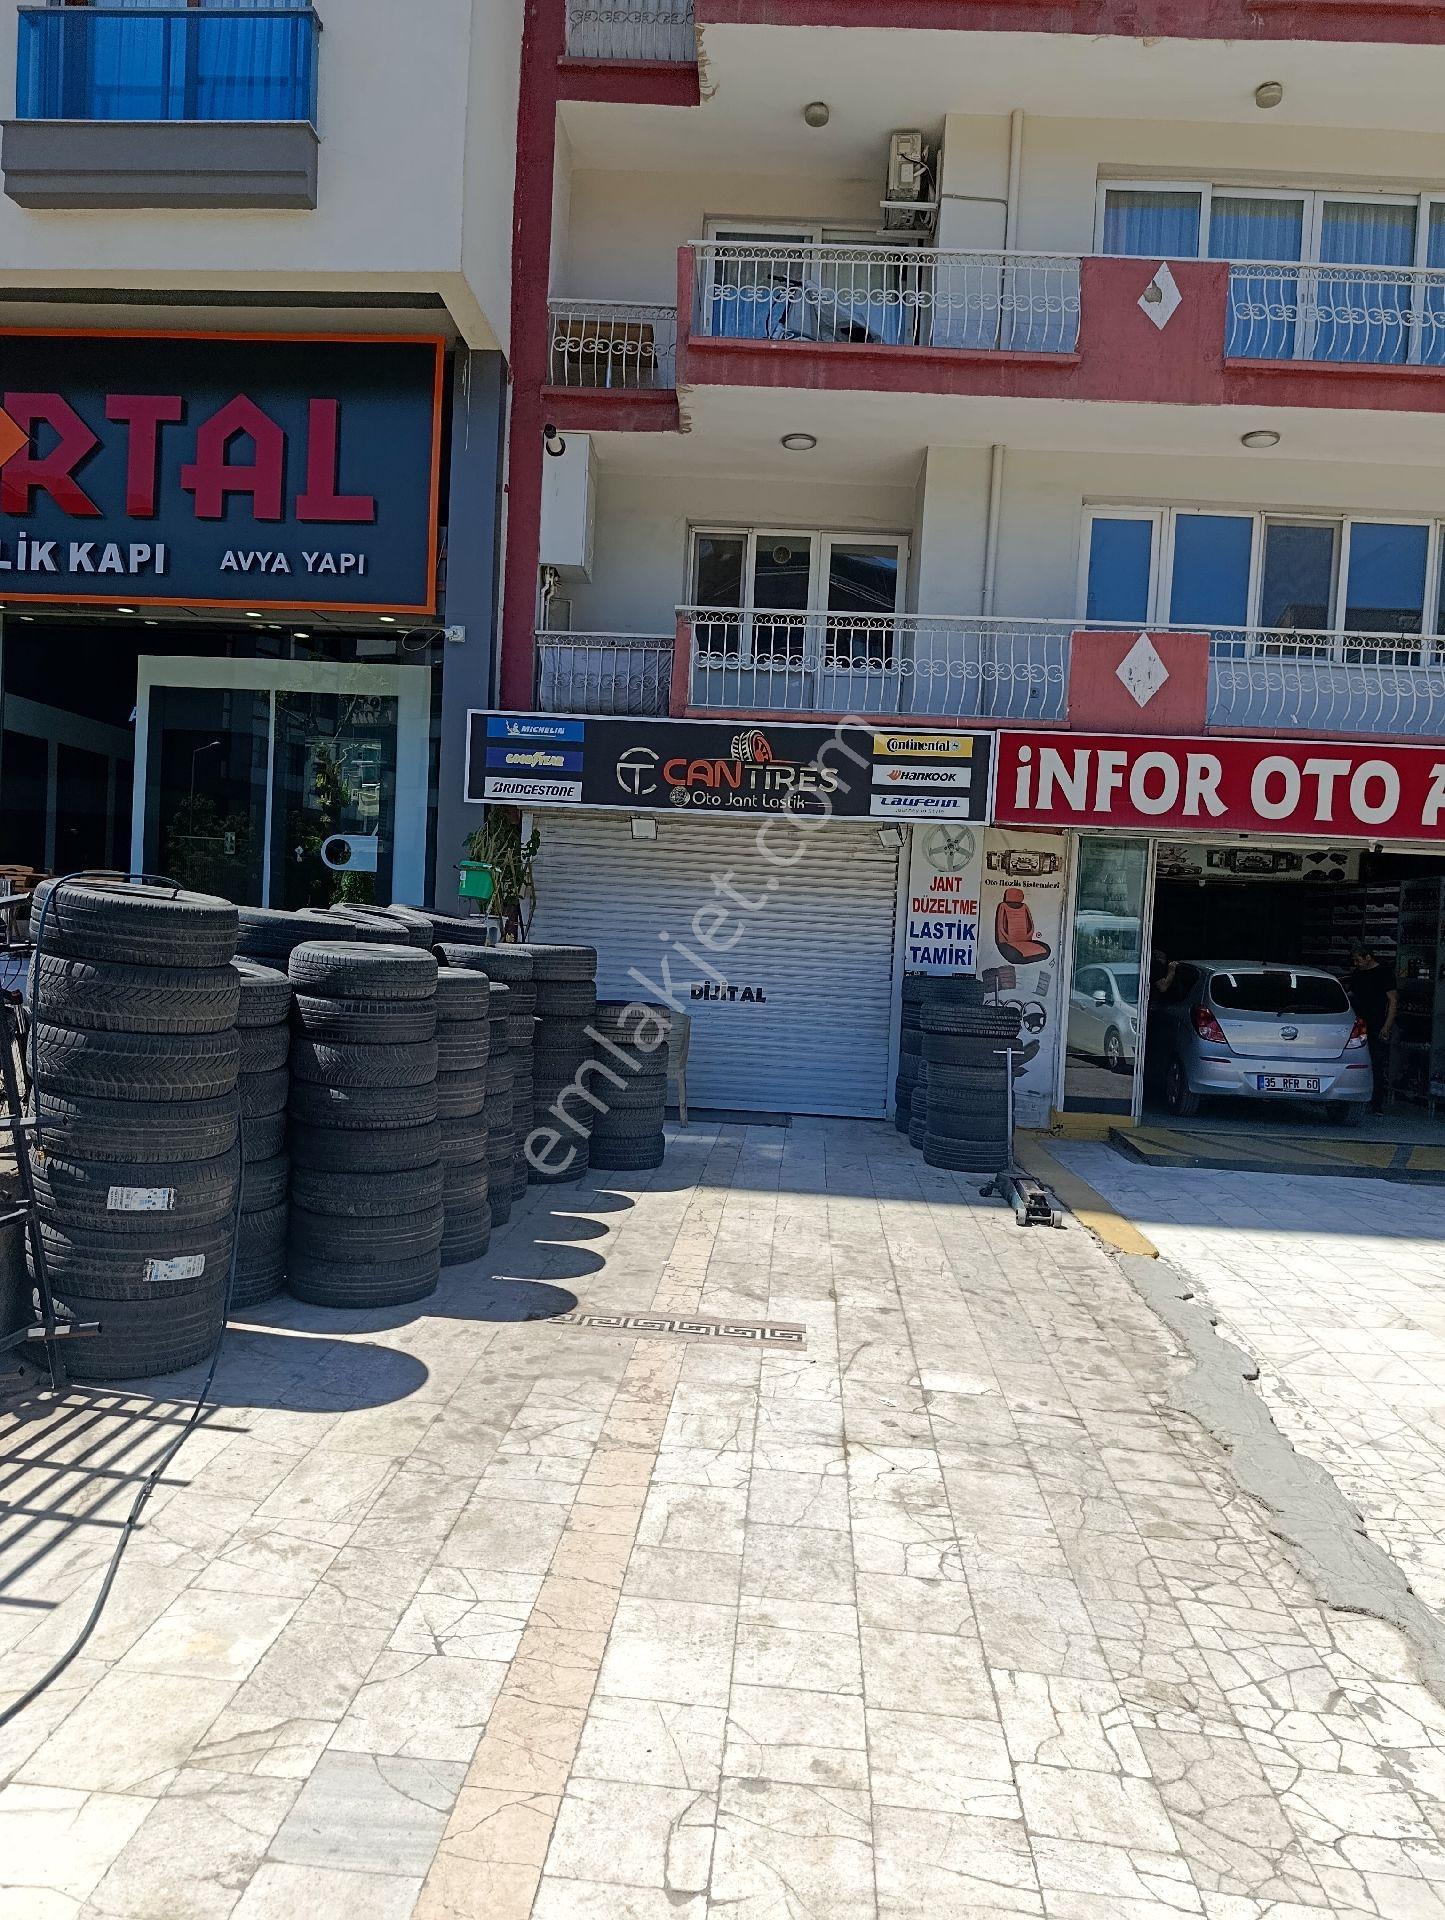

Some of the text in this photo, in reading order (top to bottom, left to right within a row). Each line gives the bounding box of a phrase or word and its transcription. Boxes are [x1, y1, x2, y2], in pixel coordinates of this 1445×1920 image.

[69, 542, 165, 574] KAPI
[220, 550, 365, 575] AVYA YAPI
[520, 725, 565, 735] MICHELIN
[886, 738, 950, 752] Continental
[505, 751, 565, 768] GOODYEAR
[492, 782, 575, 797] BRIDGESTONE
[692, 790, 806, 809] Oto Jant Lastik
[1251, 755, 1400, 825] OTO
[930, 876, 962, 893] JANT
[912, 895, 977, 916] DÜZELTME
[910, 919, 976, 941] LASTİK
[910, 944, 972, 966] TAMİRİ
[690, 981, 767, 1003] DİJİTAL
[1264, 1077, 1318, 1090] 35 RFR 60
